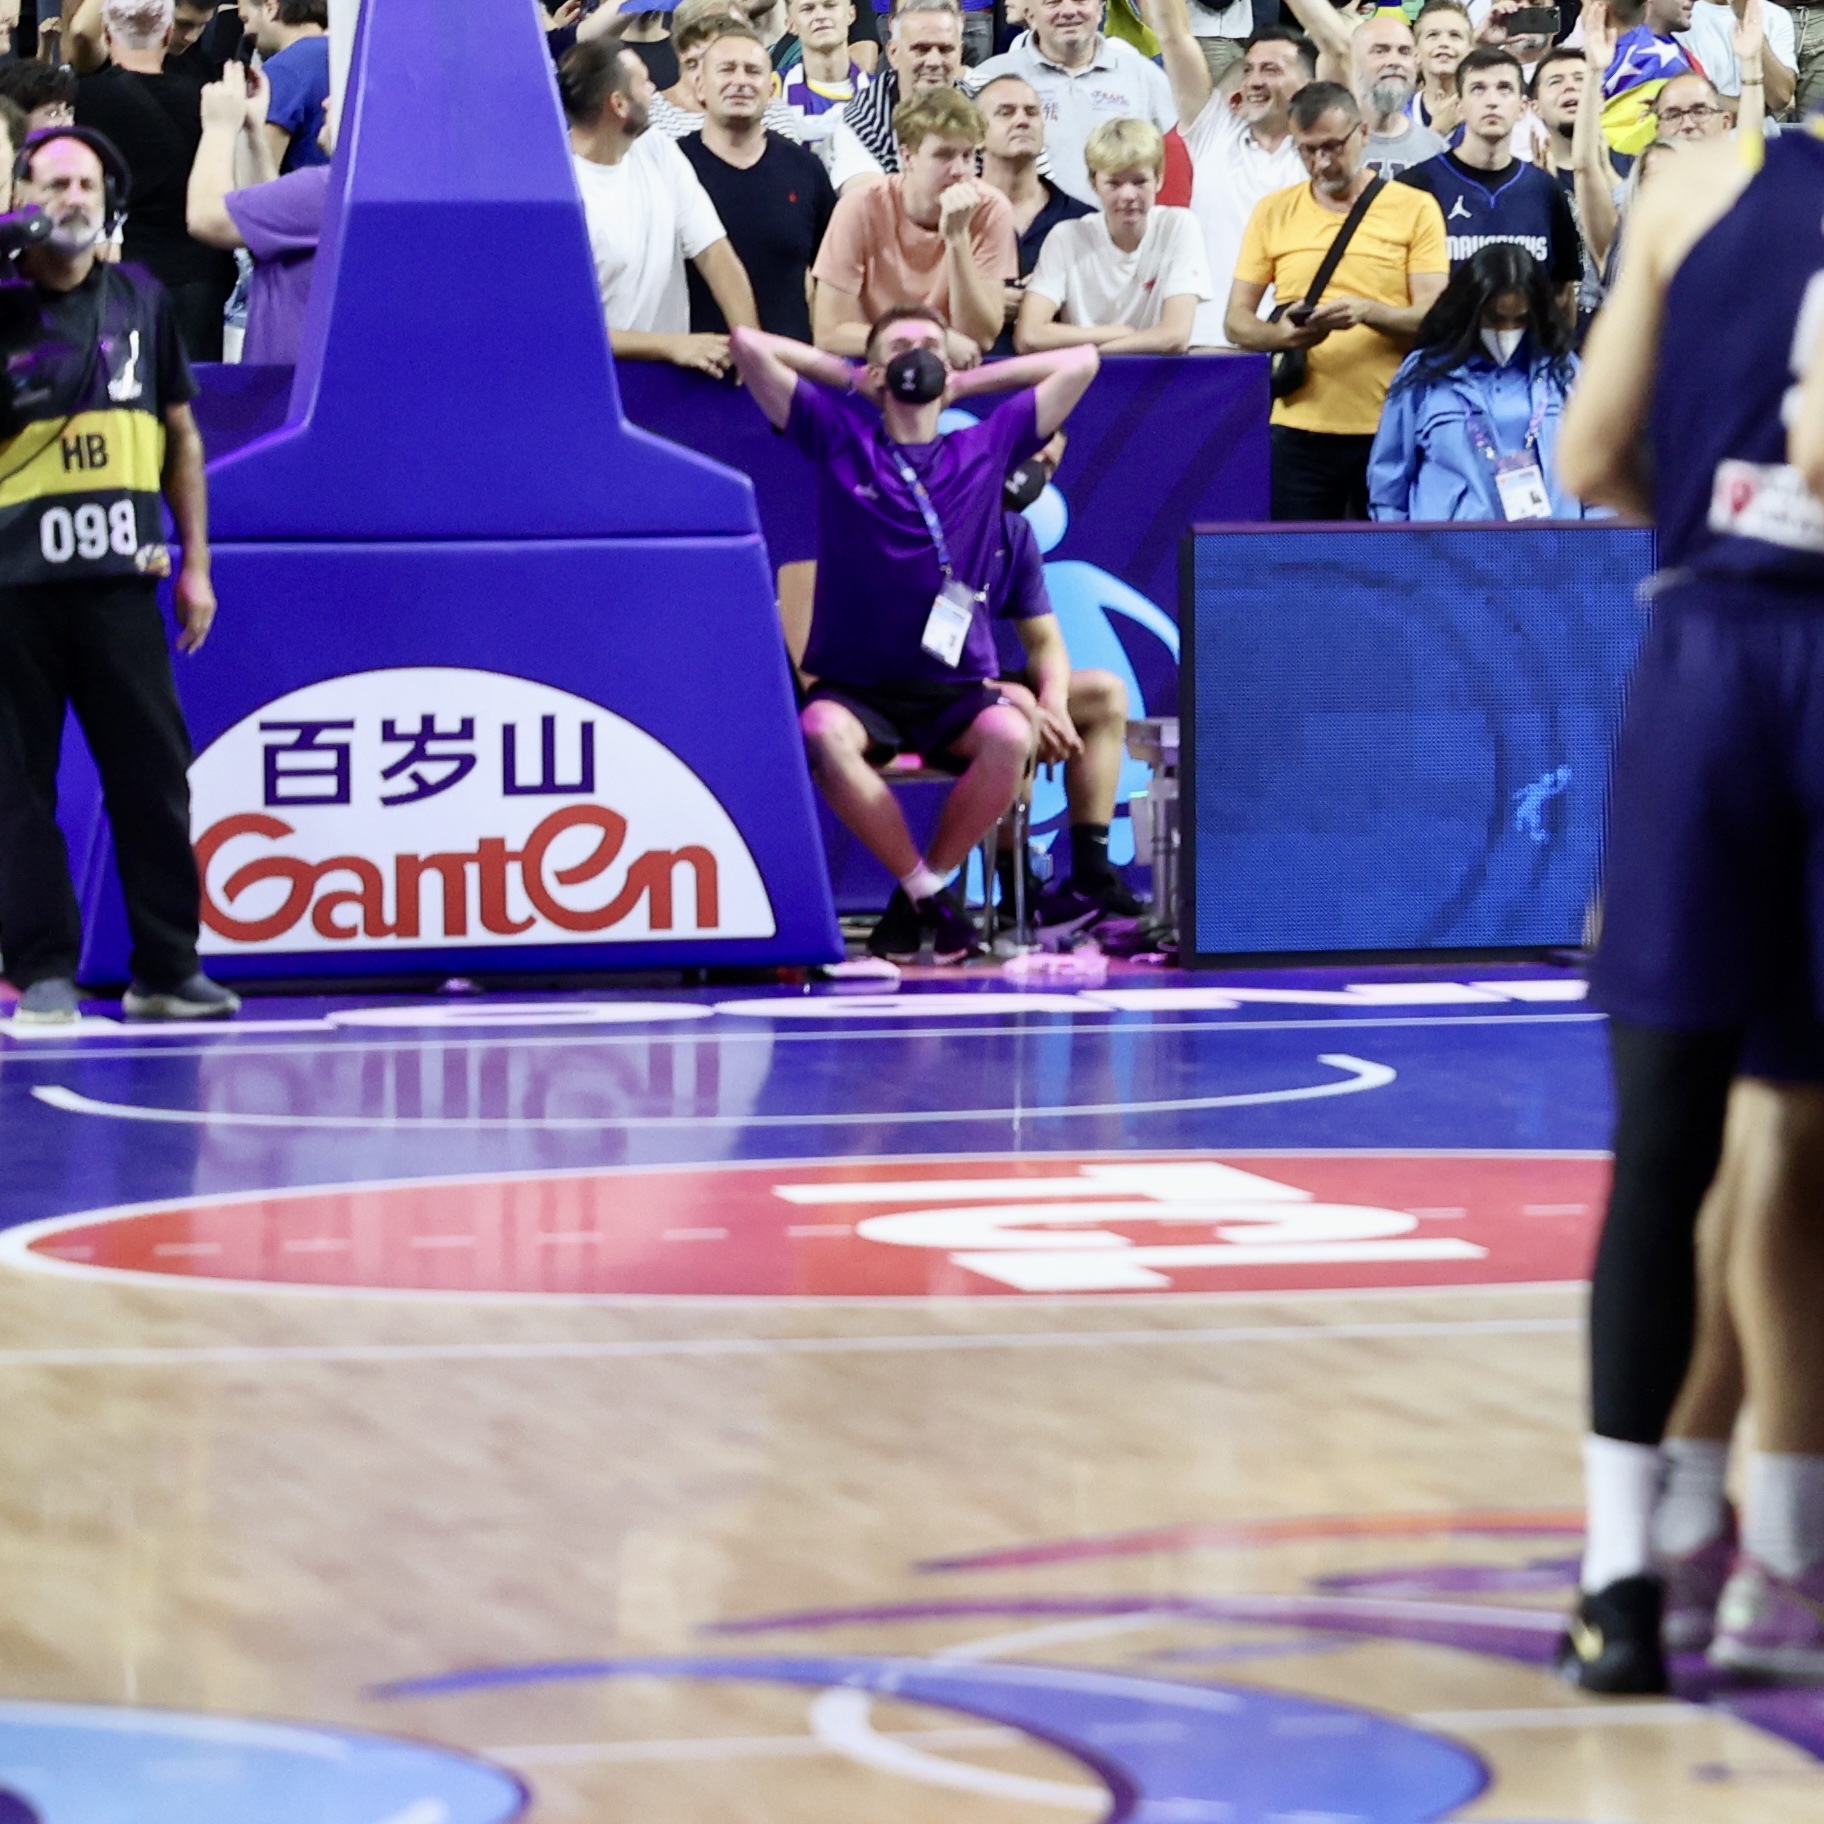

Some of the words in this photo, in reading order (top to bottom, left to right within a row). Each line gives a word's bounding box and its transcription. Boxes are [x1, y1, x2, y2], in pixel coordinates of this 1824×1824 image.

[62, 431, 107, 474] HB
[38, 499, 138, 563] 098
[258, 713, 595, 808] 百岁山
